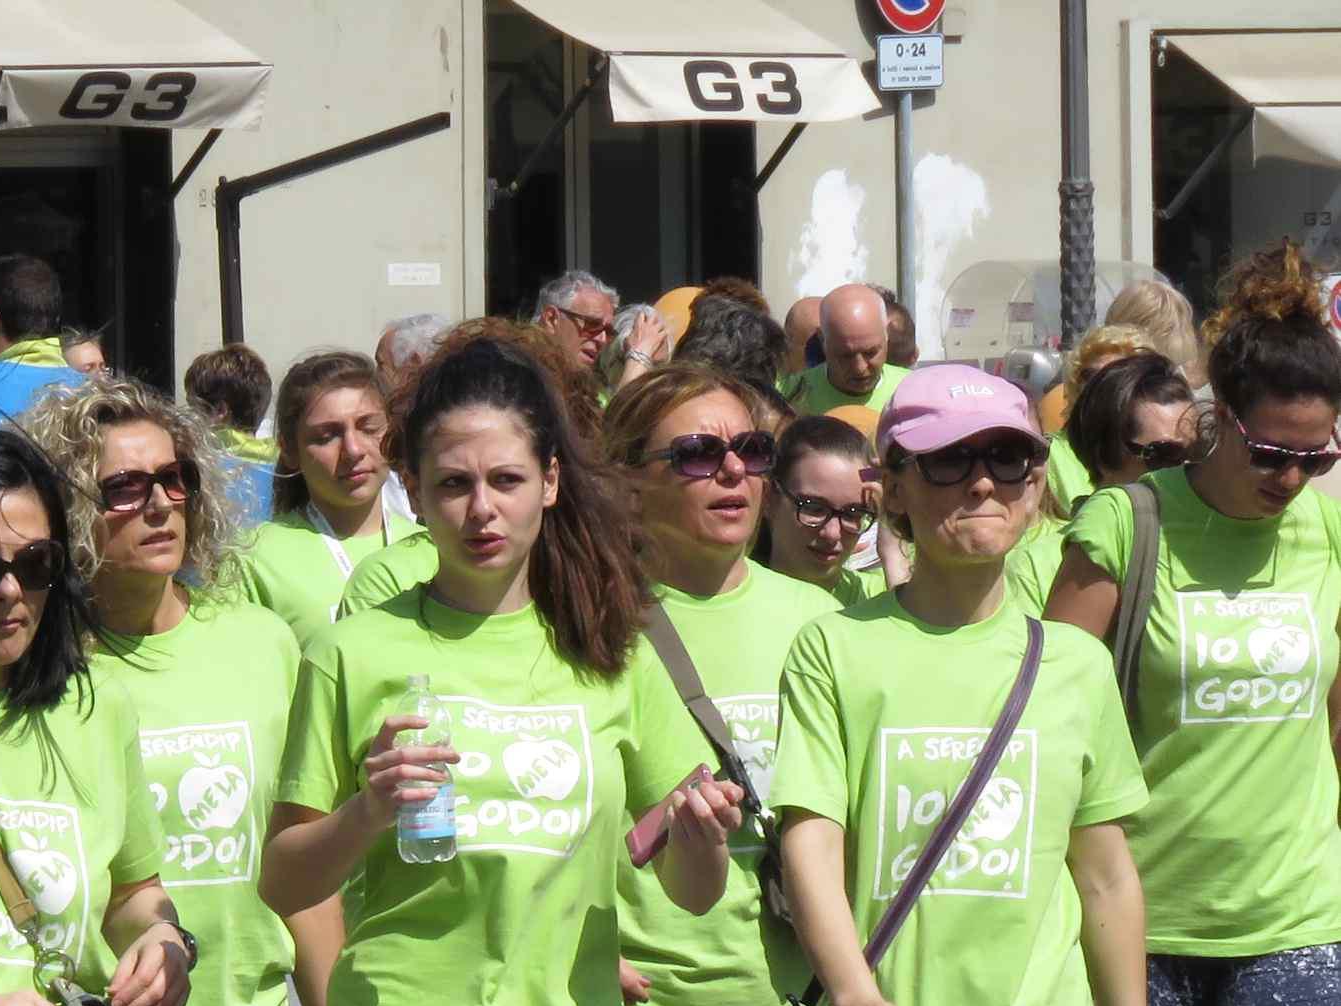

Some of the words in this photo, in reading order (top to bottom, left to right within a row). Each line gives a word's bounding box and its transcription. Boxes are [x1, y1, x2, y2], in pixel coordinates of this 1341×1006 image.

[59, 71, 196, 120] G3
[683, 60, 803, 115] G3
[1193, 601, 1207, 616] A
[462, 706, 572, 734] SERENDIP
[897, 739, 914, 760] A
[923, 736, 1026, 763] SEREP
[188, 771, 244, 828] MELA
[891, 842, 1021, 891] GDO!
